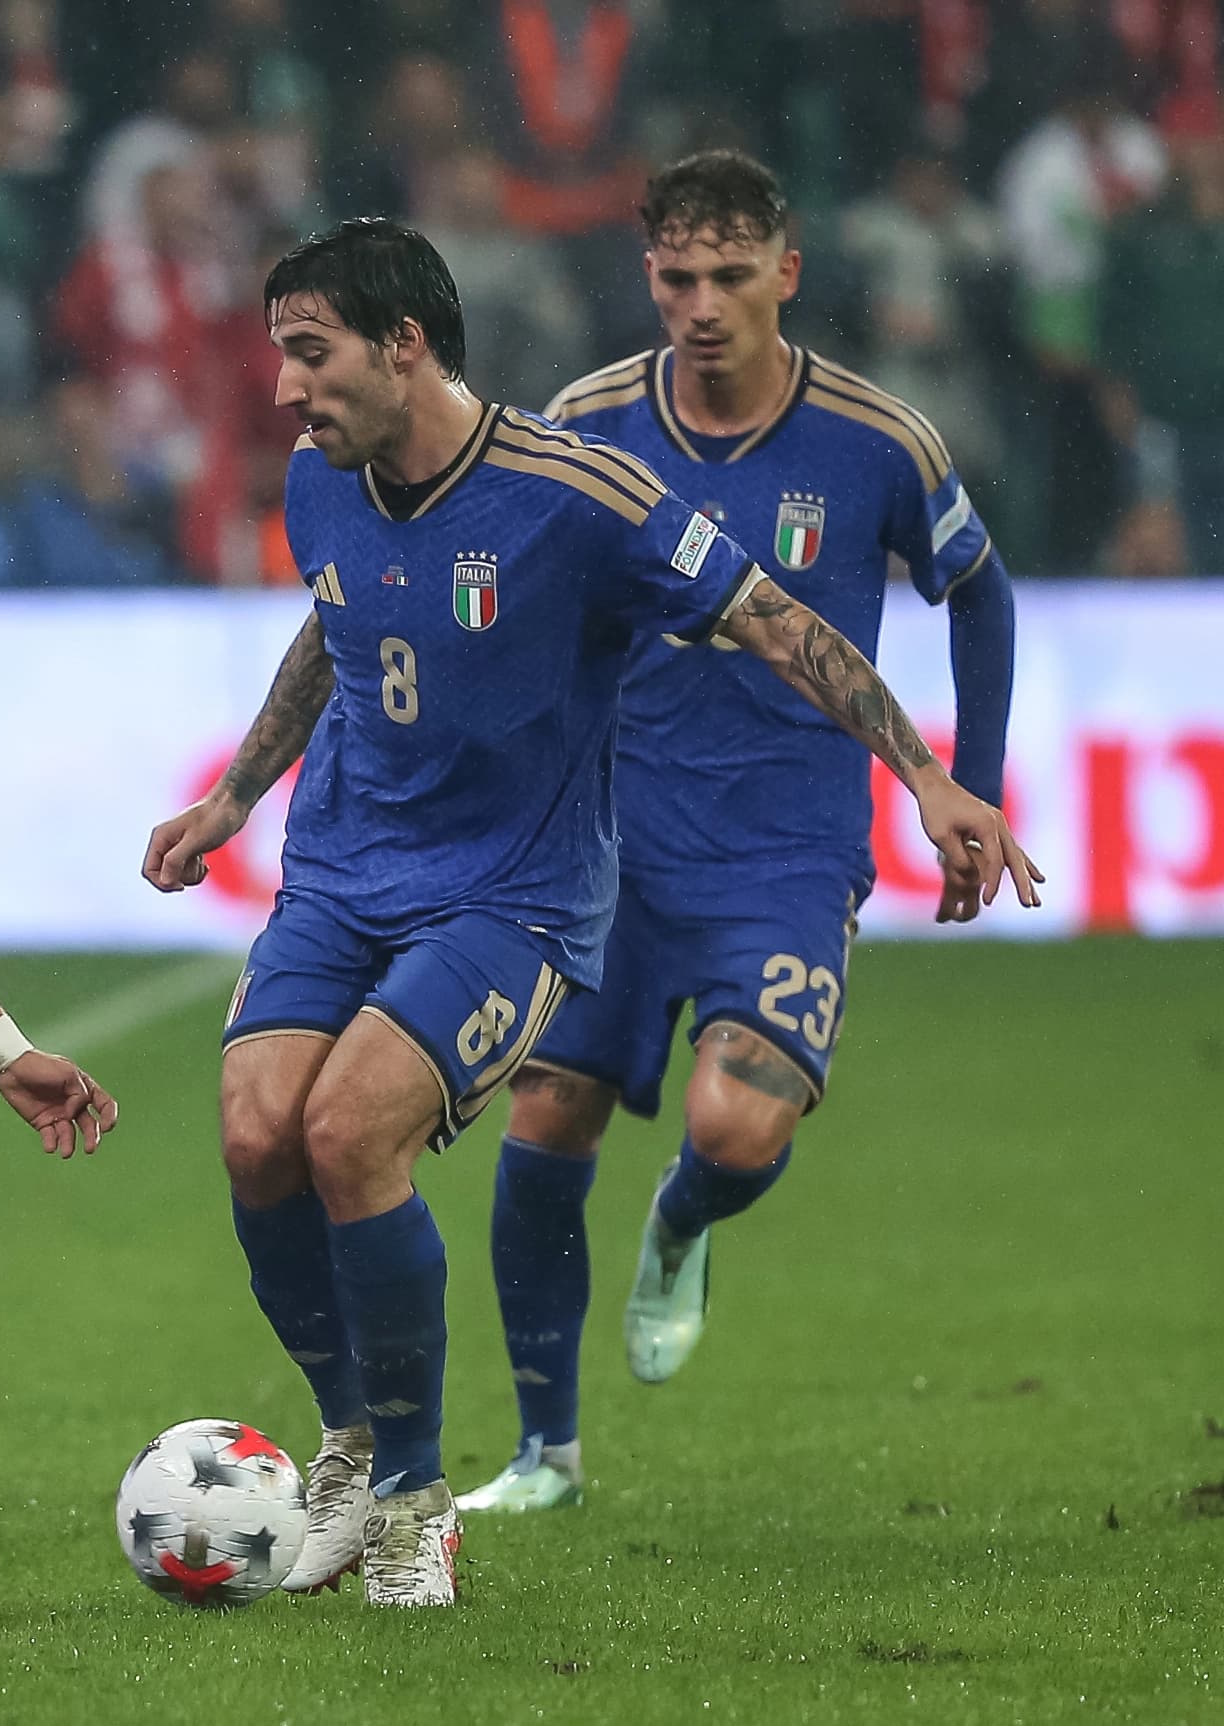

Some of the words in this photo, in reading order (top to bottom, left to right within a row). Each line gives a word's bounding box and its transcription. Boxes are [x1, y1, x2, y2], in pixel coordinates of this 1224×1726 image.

[457, 567, 493, 582] ITALIA
[380, 637, 418, 725] 8
[456, 989, 516, 1066] 8
[758, 953, 841, 1051] 23
